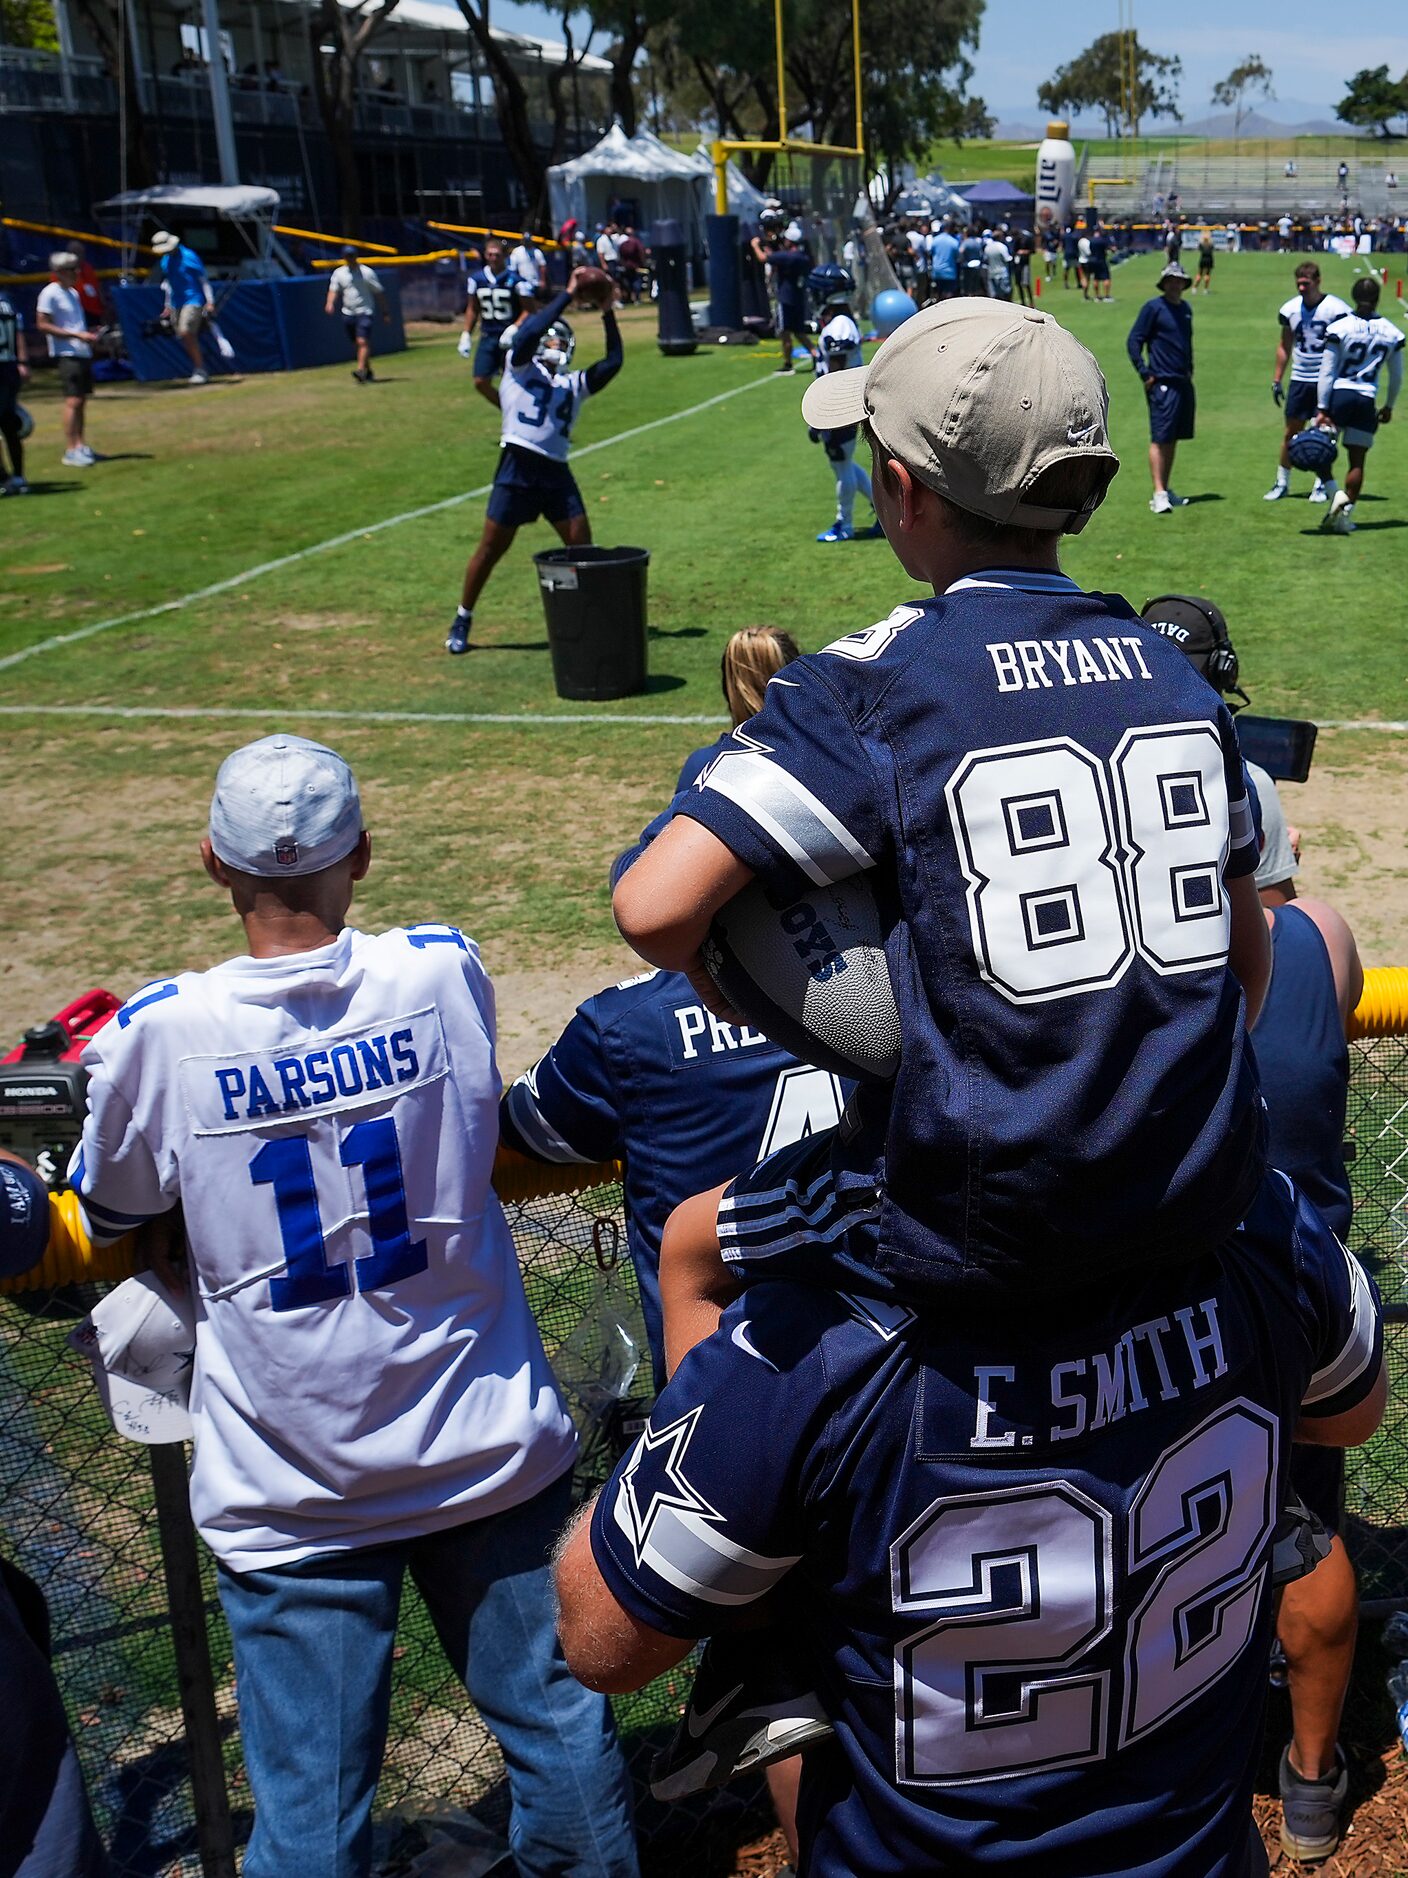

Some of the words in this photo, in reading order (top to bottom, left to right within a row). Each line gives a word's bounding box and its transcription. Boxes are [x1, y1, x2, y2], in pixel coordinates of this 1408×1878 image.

[476, 287, 512, 321] 55
[517, 377, 574, 438] 34
[985, 636, 1153, 693] BRYANT
[944, 718, 1230, 1005] 88
[774, 890, 850, 983] OYS
[3, 1086, 58, 1097] HONDA
[215, 1028, 420, 1121] PARSONS
[248, 1116, 429, 1313] 11
[968, 1364, 1035, 1450] E.
[1049, 1297, 1230, 1442] SMITH
[888, 1395, 1281, 1786] 22
